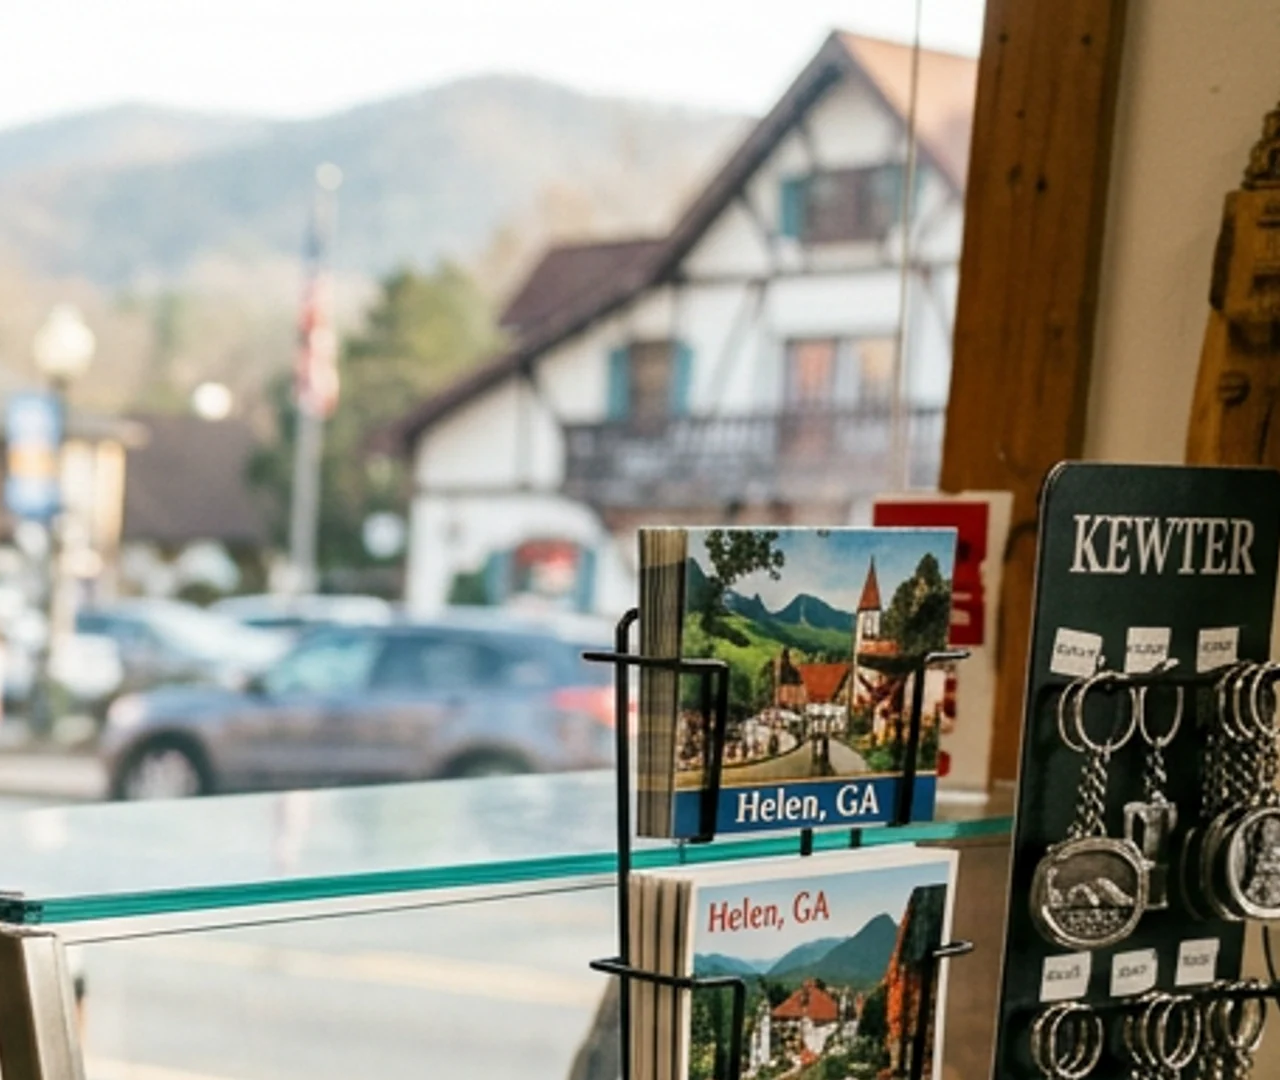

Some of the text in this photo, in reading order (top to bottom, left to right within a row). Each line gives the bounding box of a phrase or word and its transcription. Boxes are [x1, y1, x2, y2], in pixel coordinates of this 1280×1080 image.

[1069, 513, 1257, 576] KEWTER
[735, 783, 880, 823] Helen, GA
[707, 889, 830, 933] Helen, GA
